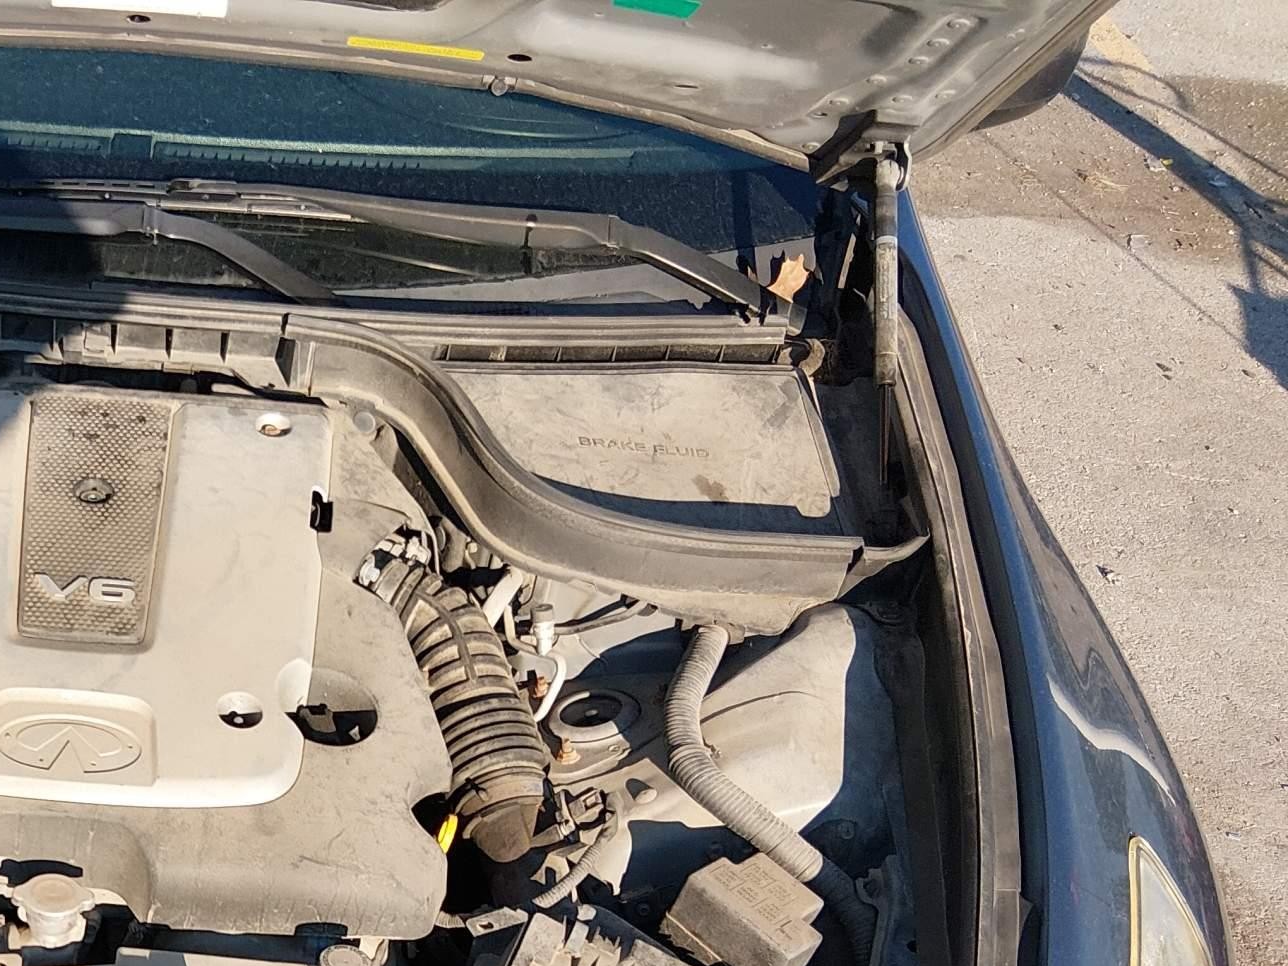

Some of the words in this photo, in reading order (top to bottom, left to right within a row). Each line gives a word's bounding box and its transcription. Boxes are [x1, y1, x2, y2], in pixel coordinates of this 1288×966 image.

[577, 436, 646, 451] BRAKE
[652, 444, 710, 458] FLUID
[33, 571, 136, 604] V6
